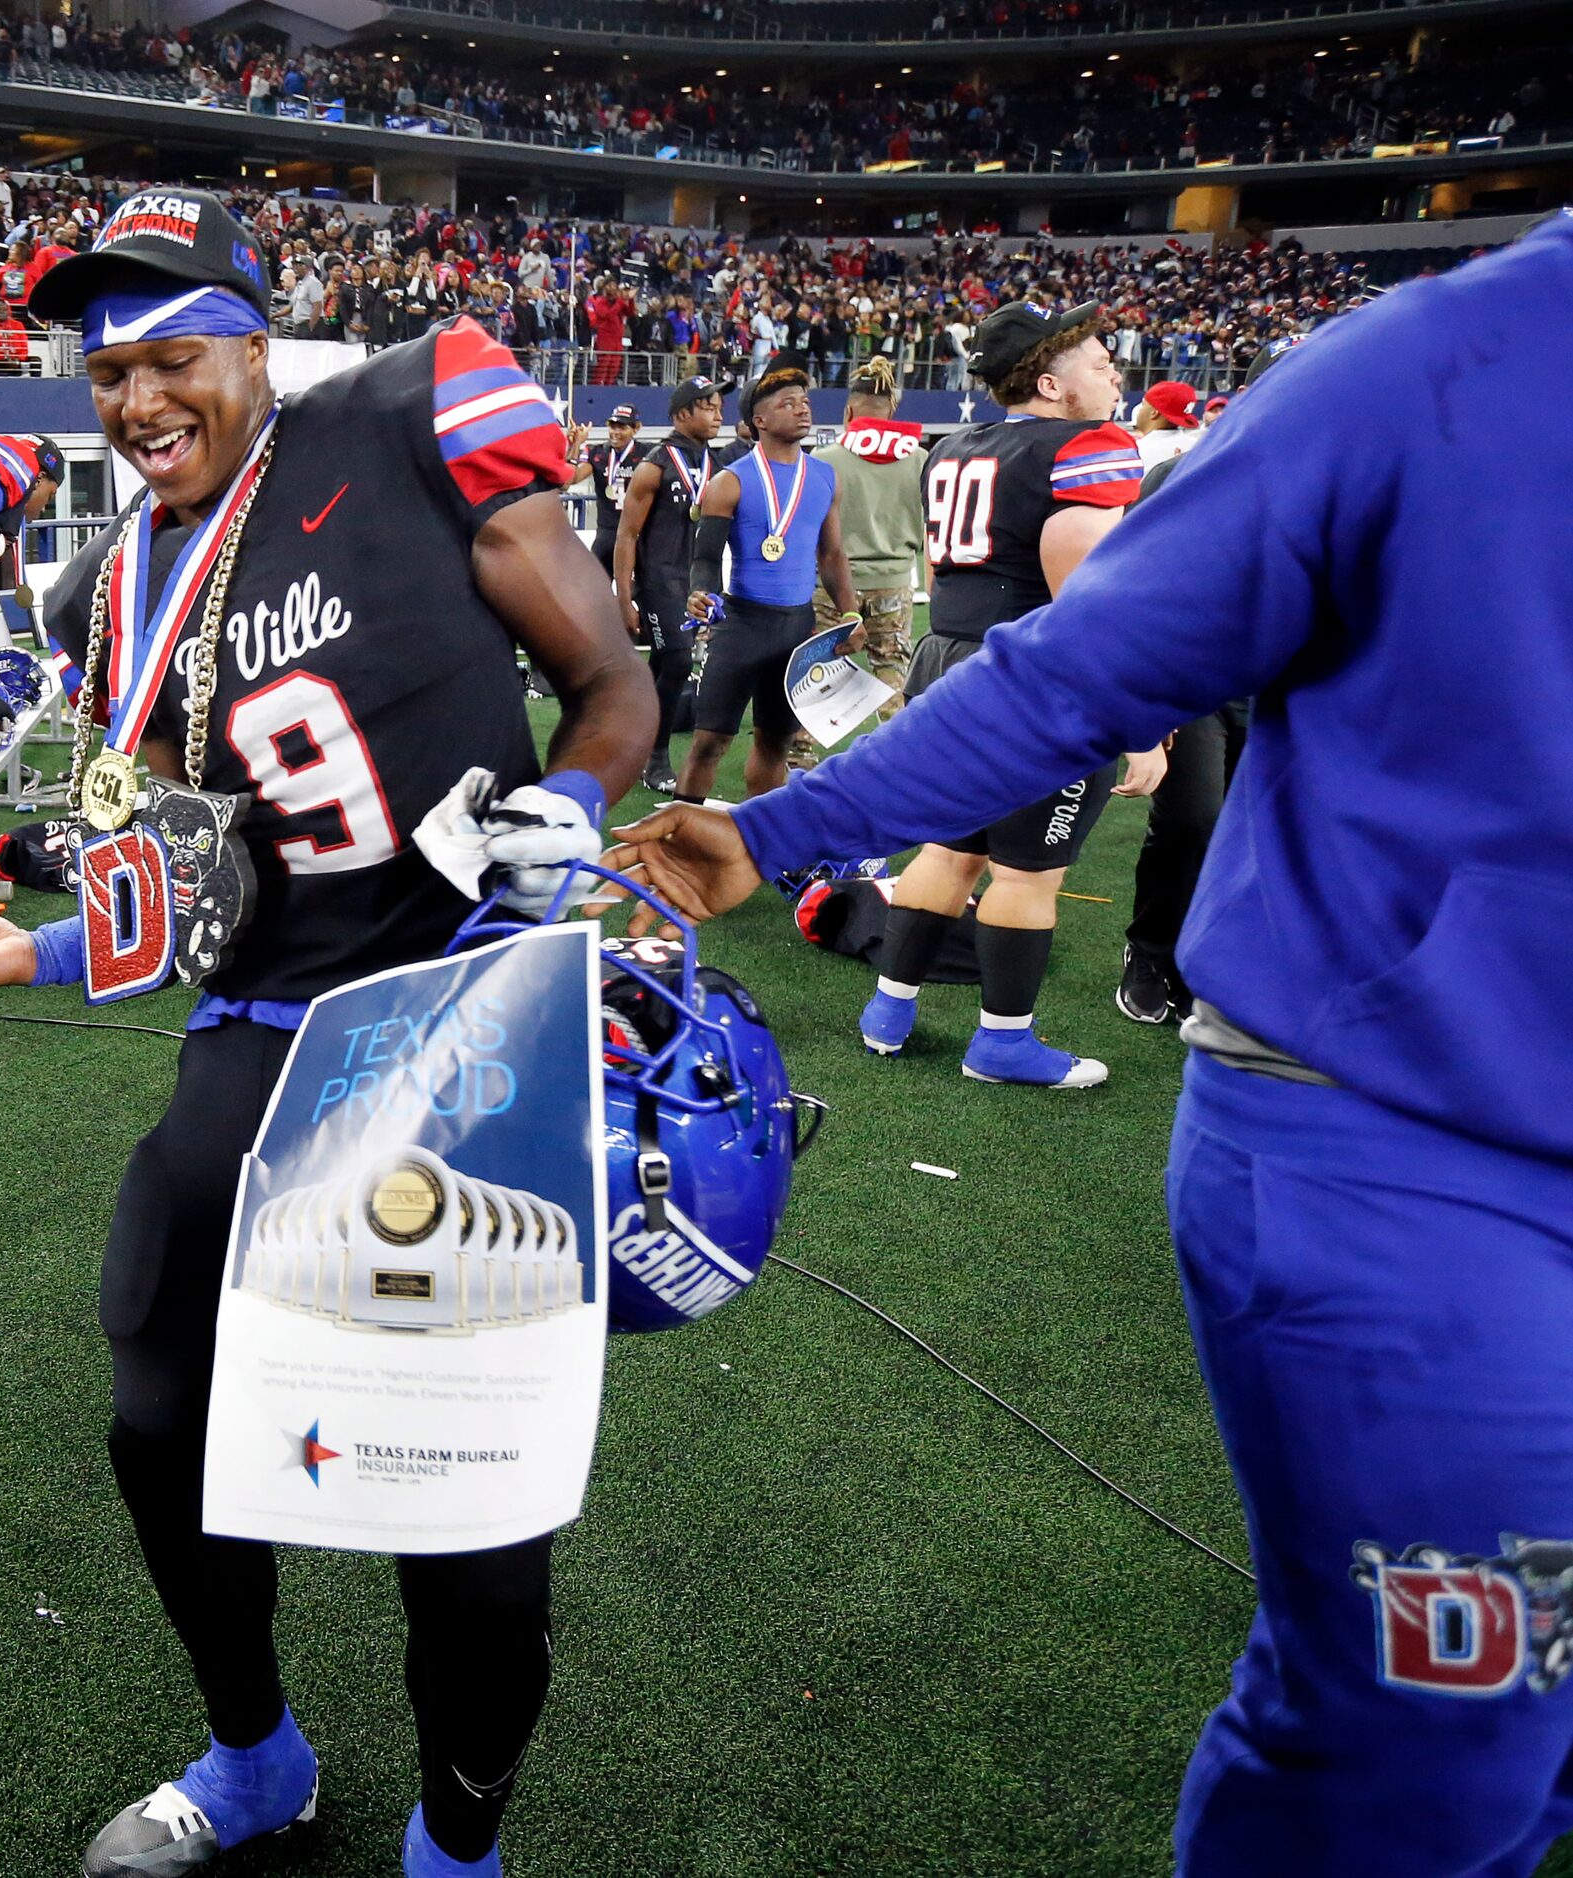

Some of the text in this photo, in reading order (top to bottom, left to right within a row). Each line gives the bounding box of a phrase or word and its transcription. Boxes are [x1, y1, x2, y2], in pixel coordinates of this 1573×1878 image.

[105, 213, 199, 241] STRONG
[114, 195, 202, 224] TEXAS
[135, 228, 195, 248] CHAMPIONSHIPS
[927, 457, 1000, 567] 90
[224, 668, 401, 876] 9
[93, 800, 114, 815] STATE
[1044, 779, 1086, 846] D'Ville
[76, 822, 177, 1006] D
[342, 997, 507, 1070] TEXAS
[311, 1059, 517, 1123] PROUD
[354, 1443, 520, 1463] TEXAS FARM BUREAU
[356, 1458, 450, 1477] INSURANCE
[1376, 1563, 1530, 1698] D
